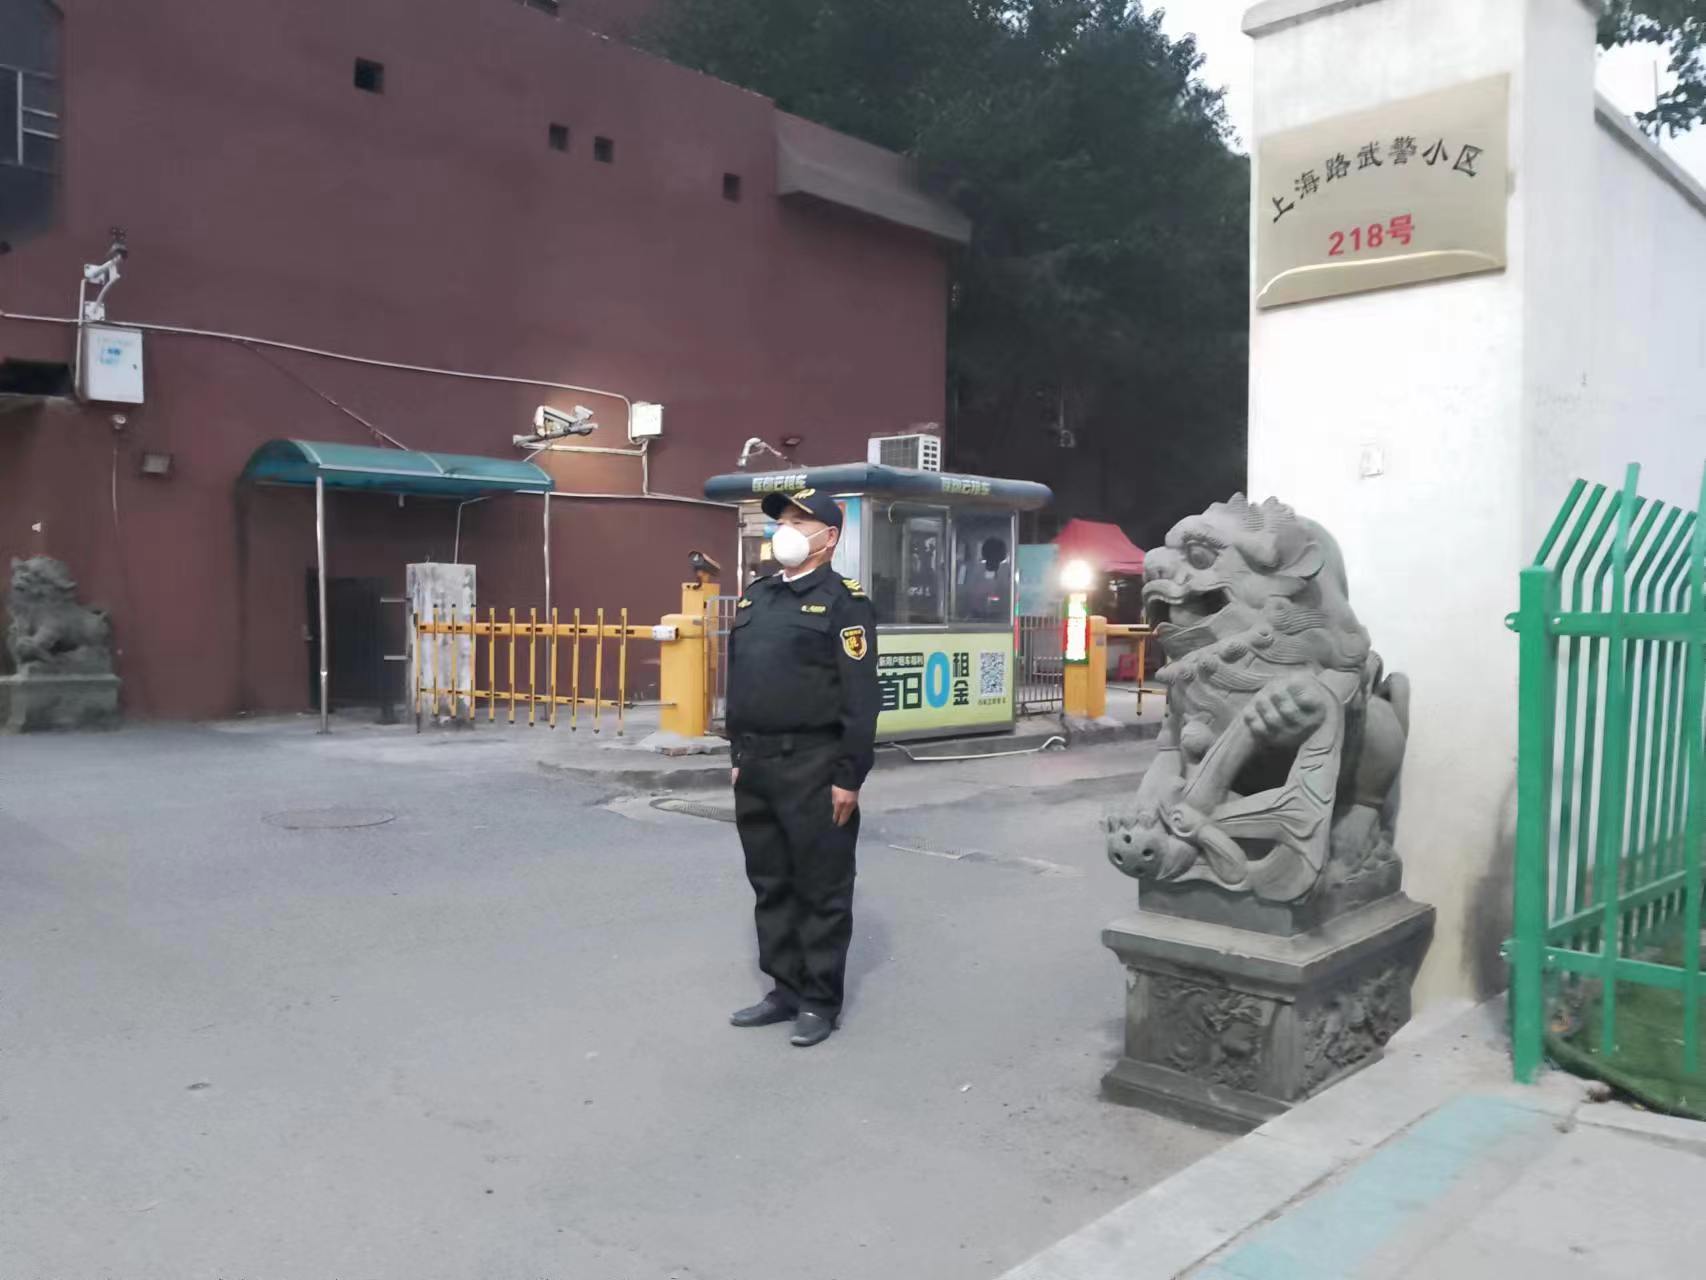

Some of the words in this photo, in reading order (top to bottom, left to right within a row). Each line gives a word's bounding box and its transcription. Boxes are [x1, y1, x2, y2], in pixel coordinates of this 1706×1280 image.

[1271, 135, 1484, 223] 上海路武警小区
[1327, 214, 1415, 256] 218号
